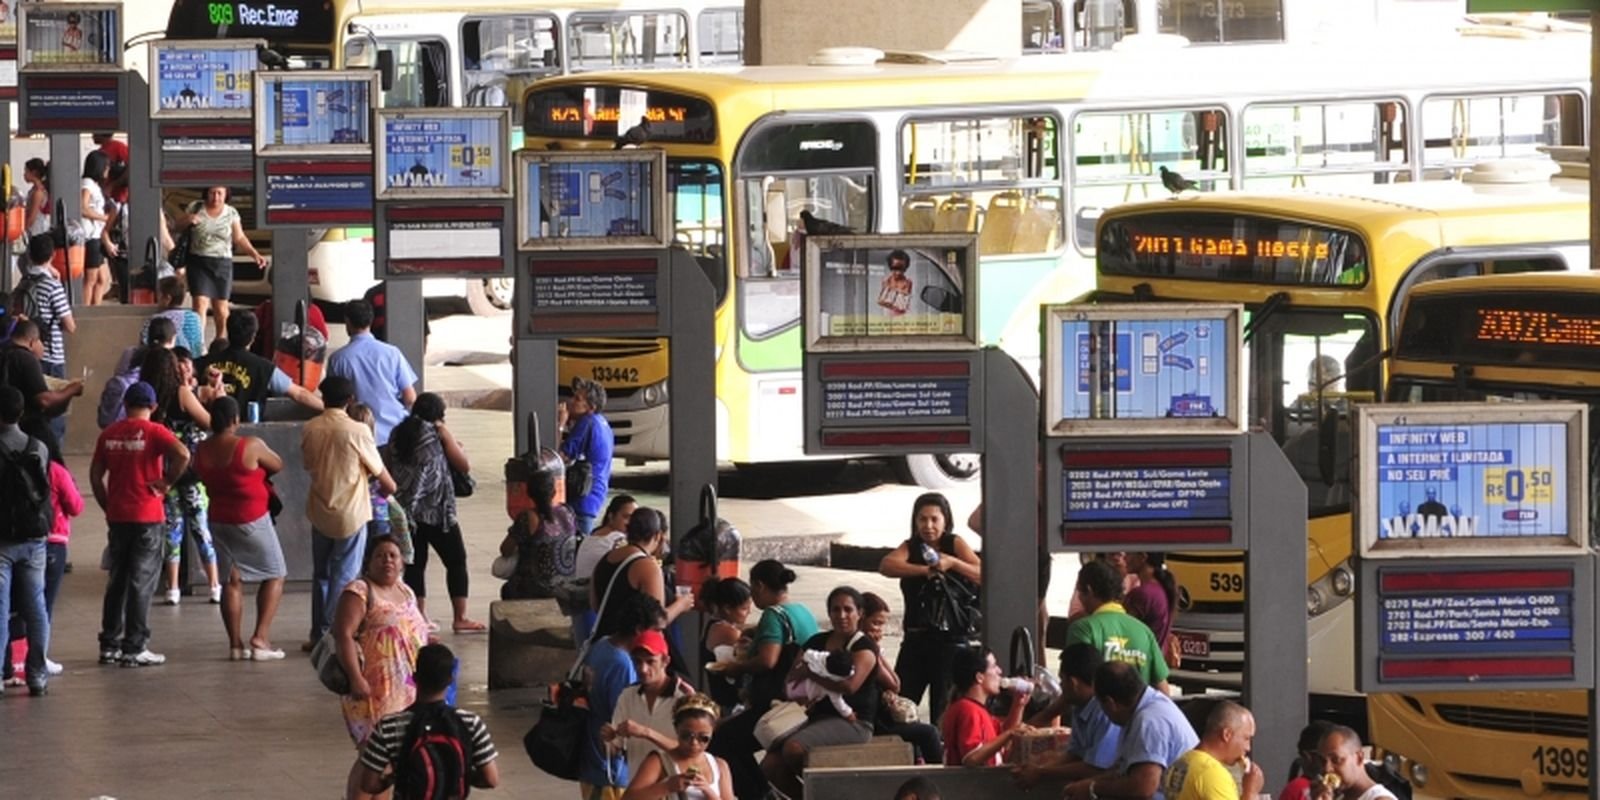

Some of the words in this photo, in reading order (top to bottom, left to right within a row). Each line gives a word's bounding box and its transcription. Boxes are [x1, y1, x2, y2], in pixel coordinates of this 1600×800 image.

[208, 3, 233, 25] 809
[592, 365, 639, 383] 133442
[1389, 432, 1437, 445] INFINITY
[1440, 431, 1465, 444] WEB
[1388, 453, 1396, 465] A
[1398, 452, 1448, 465] INTERNET
[1450, 451, 1505, 464] ILIMITADA
[1387, 469, 1404, 482] NO
[1406, 468, 1427, 481] SEU
[1428, 466, 1450, 481] PRÉ
[1210, 572, 1243, 593] 539
[1385, 599, 1410, 611] 0270
[1498, 597, 1526, 606] Maria
[1528, 596, 1555, 606] Q400
[1388, 610, 1411, 620] 2701
[1503, 608, 1531, 617] Maria
[1532, 606, 1561, 617] Q400
[1387, 620, 1411, 630] 2702
[1464, 631, 1485, 641] 300
[1494, 629, 1516, 640] 400
[1532, 745, 1590, 779] 1399
